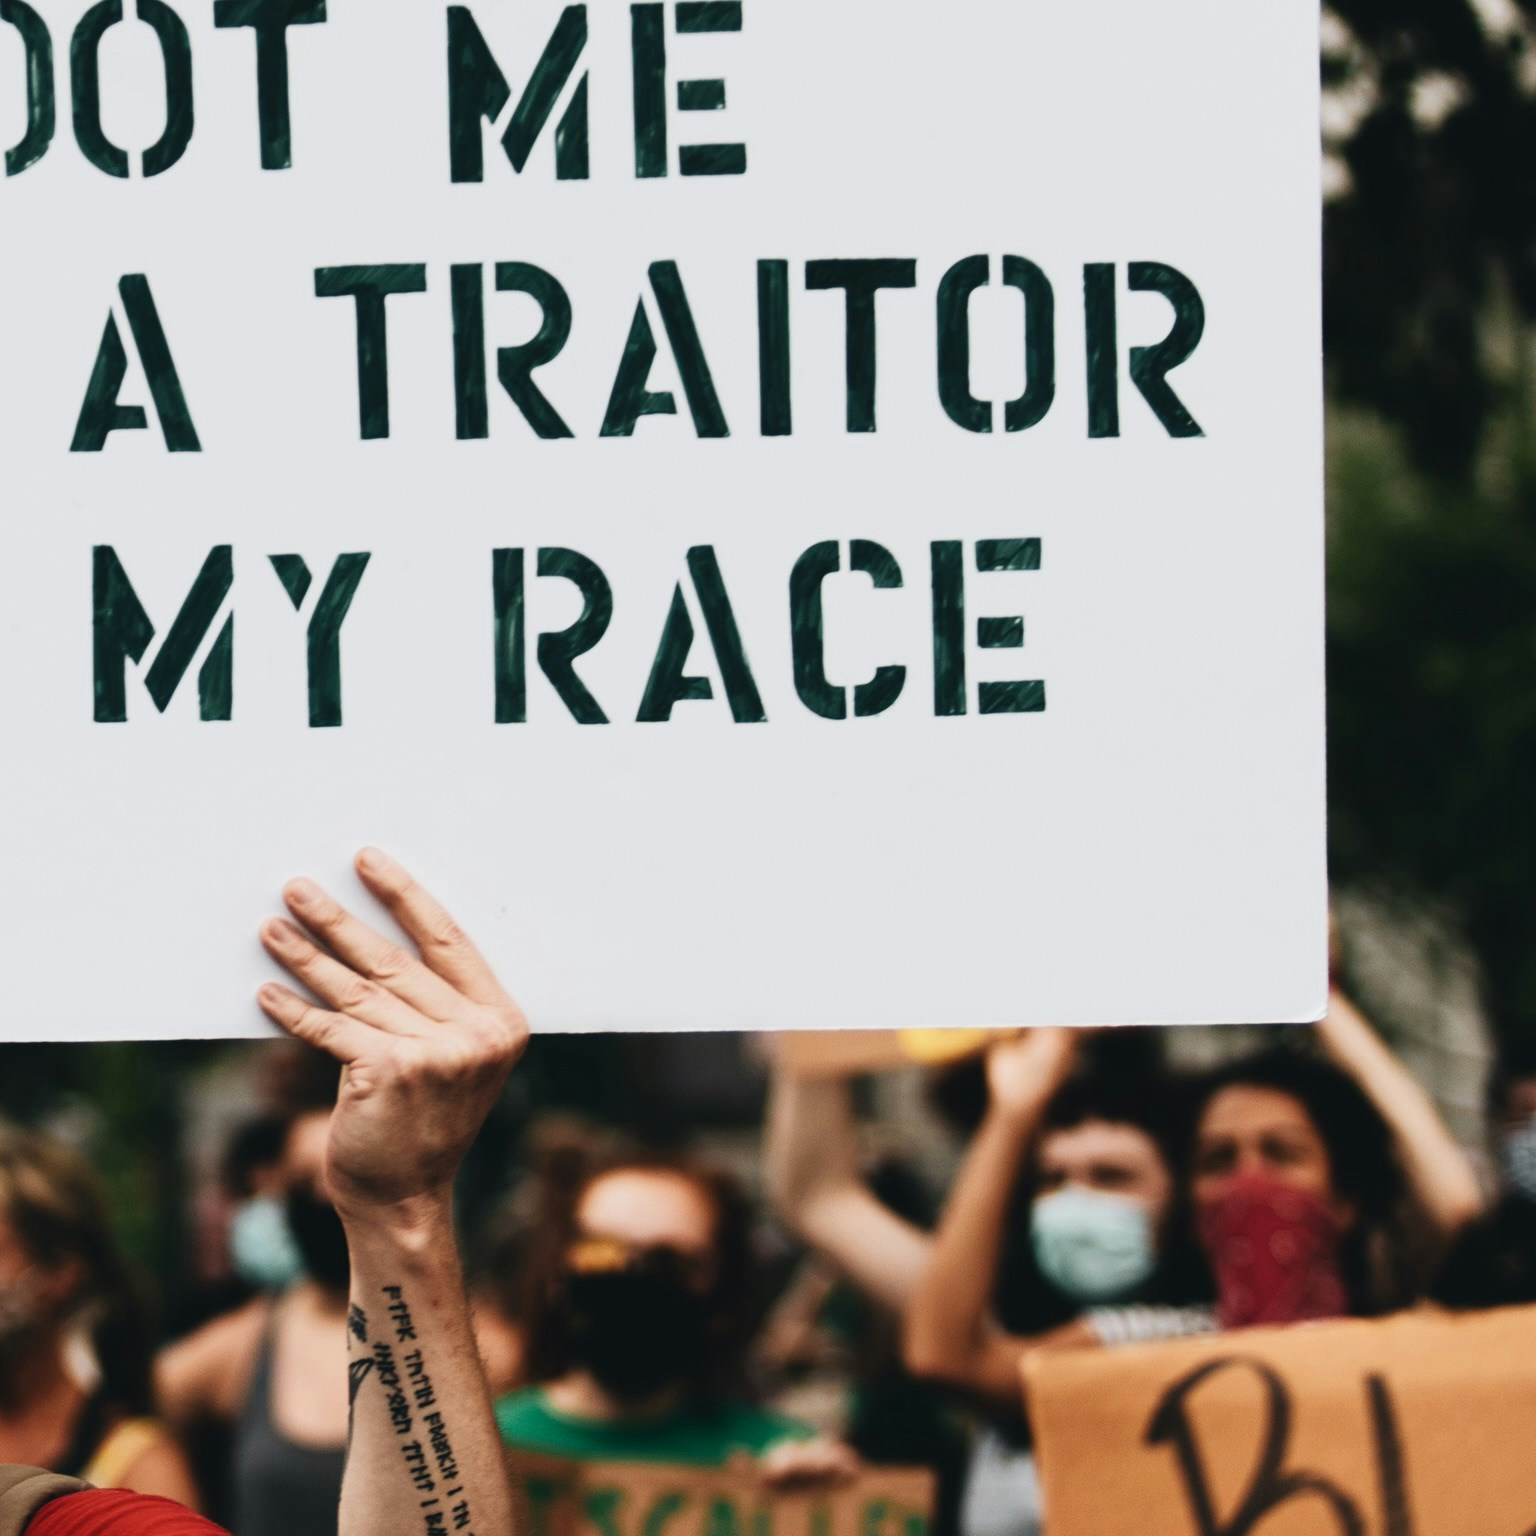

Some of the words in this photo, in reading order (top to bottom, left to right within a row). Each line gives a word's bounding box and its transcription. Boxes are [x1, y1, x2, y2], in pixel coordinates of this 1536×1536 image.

[447, 0, 747, 184] ME
[70, 274, 203, 453] A
[314, 254, 1206, 441] TRAITOR
[93, 545, 372, 729] MY
[493, 537, 1047, 725] RACE
